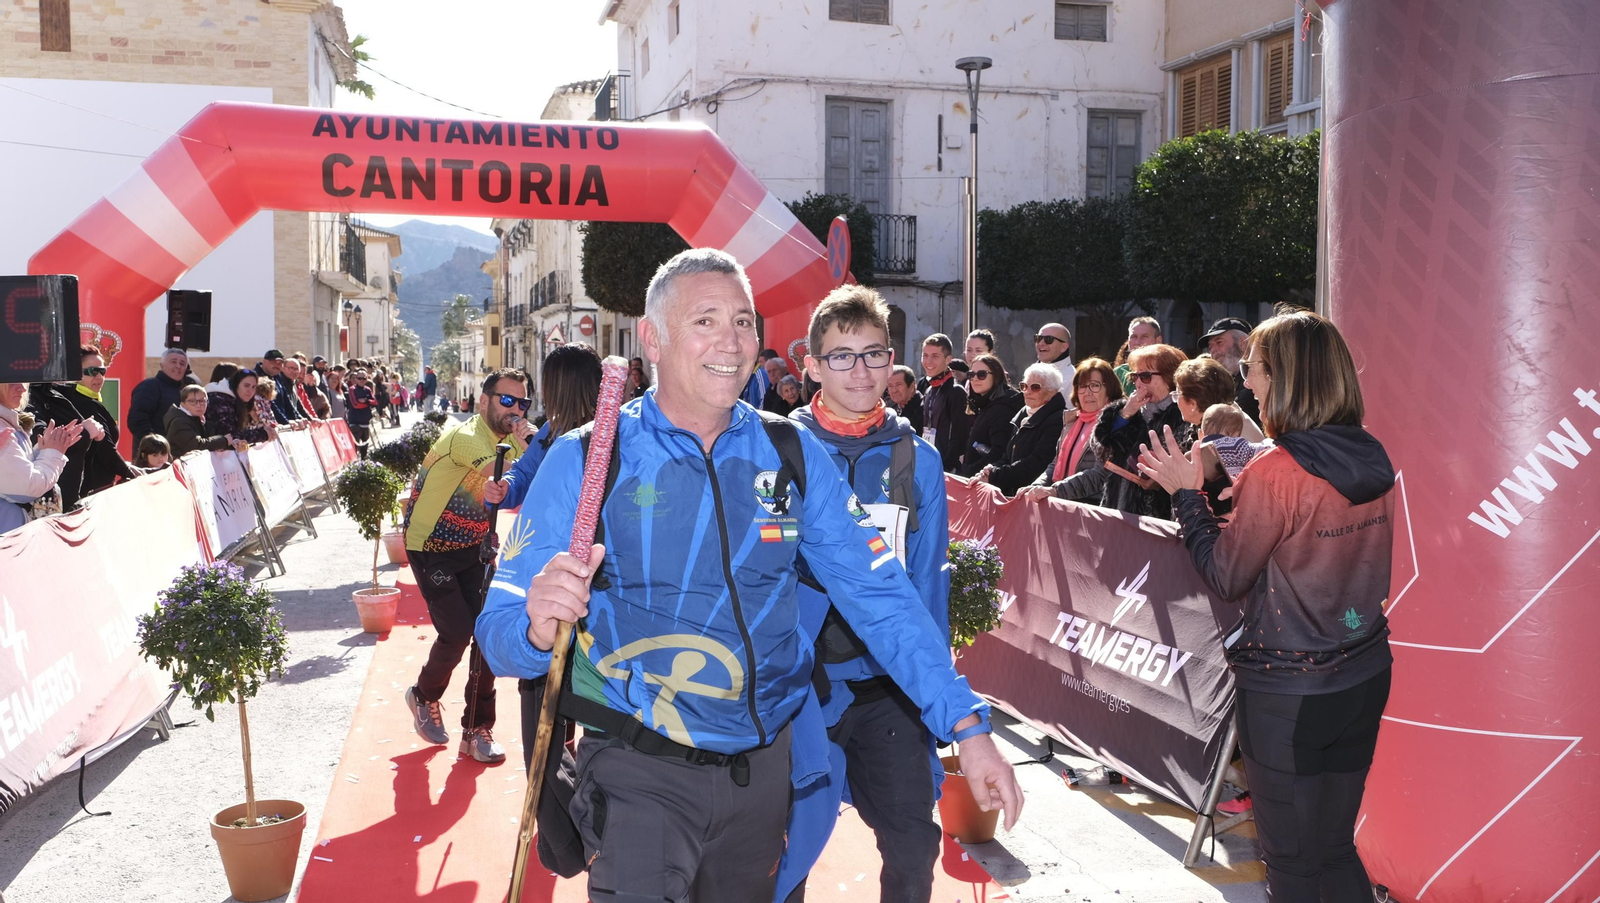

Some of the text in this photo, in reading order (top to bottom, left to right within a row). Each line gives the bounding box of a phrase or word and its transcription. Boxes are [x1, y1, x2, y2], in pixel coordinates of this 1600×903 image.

[312, 113, 620, 151] AYUNTAMIENTO
[321, 152, 610, 207] CANTORIA
[1316, 527, 1344, 538] VALLE
[1345, 524, 1354, 534] DE
[1049, 611, 1194, 688] TEAMERGY
[1061, 672, 1132, 714] www.teamergy.es
